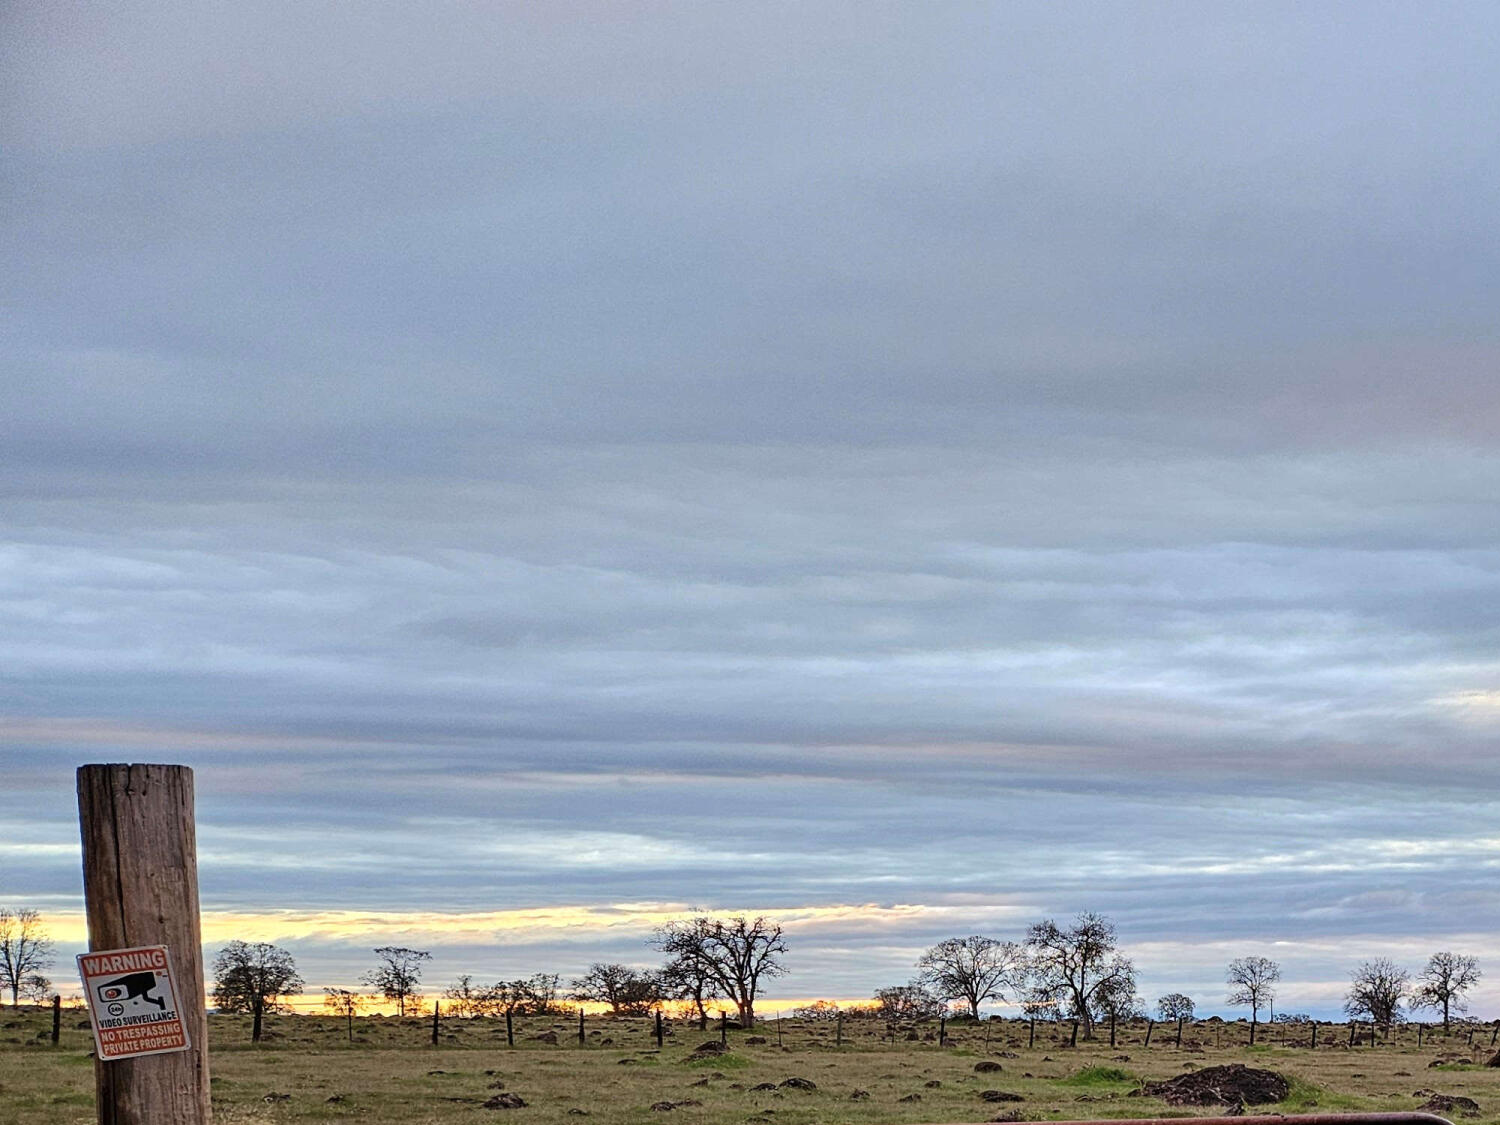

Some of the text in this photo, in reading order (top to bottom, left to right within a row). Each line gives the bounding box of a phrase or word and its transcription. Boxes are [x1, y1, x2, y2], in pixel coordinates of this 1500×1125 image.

[83, 951, 164, 974] WARNING
[99, 1011, 177, 1028] VIDEO SURVEILLANCE
[101, 1023, 180, 1042] NO TRESPASSING
[104, 1035, 182, 1054] PRIVATE PROPERTY
